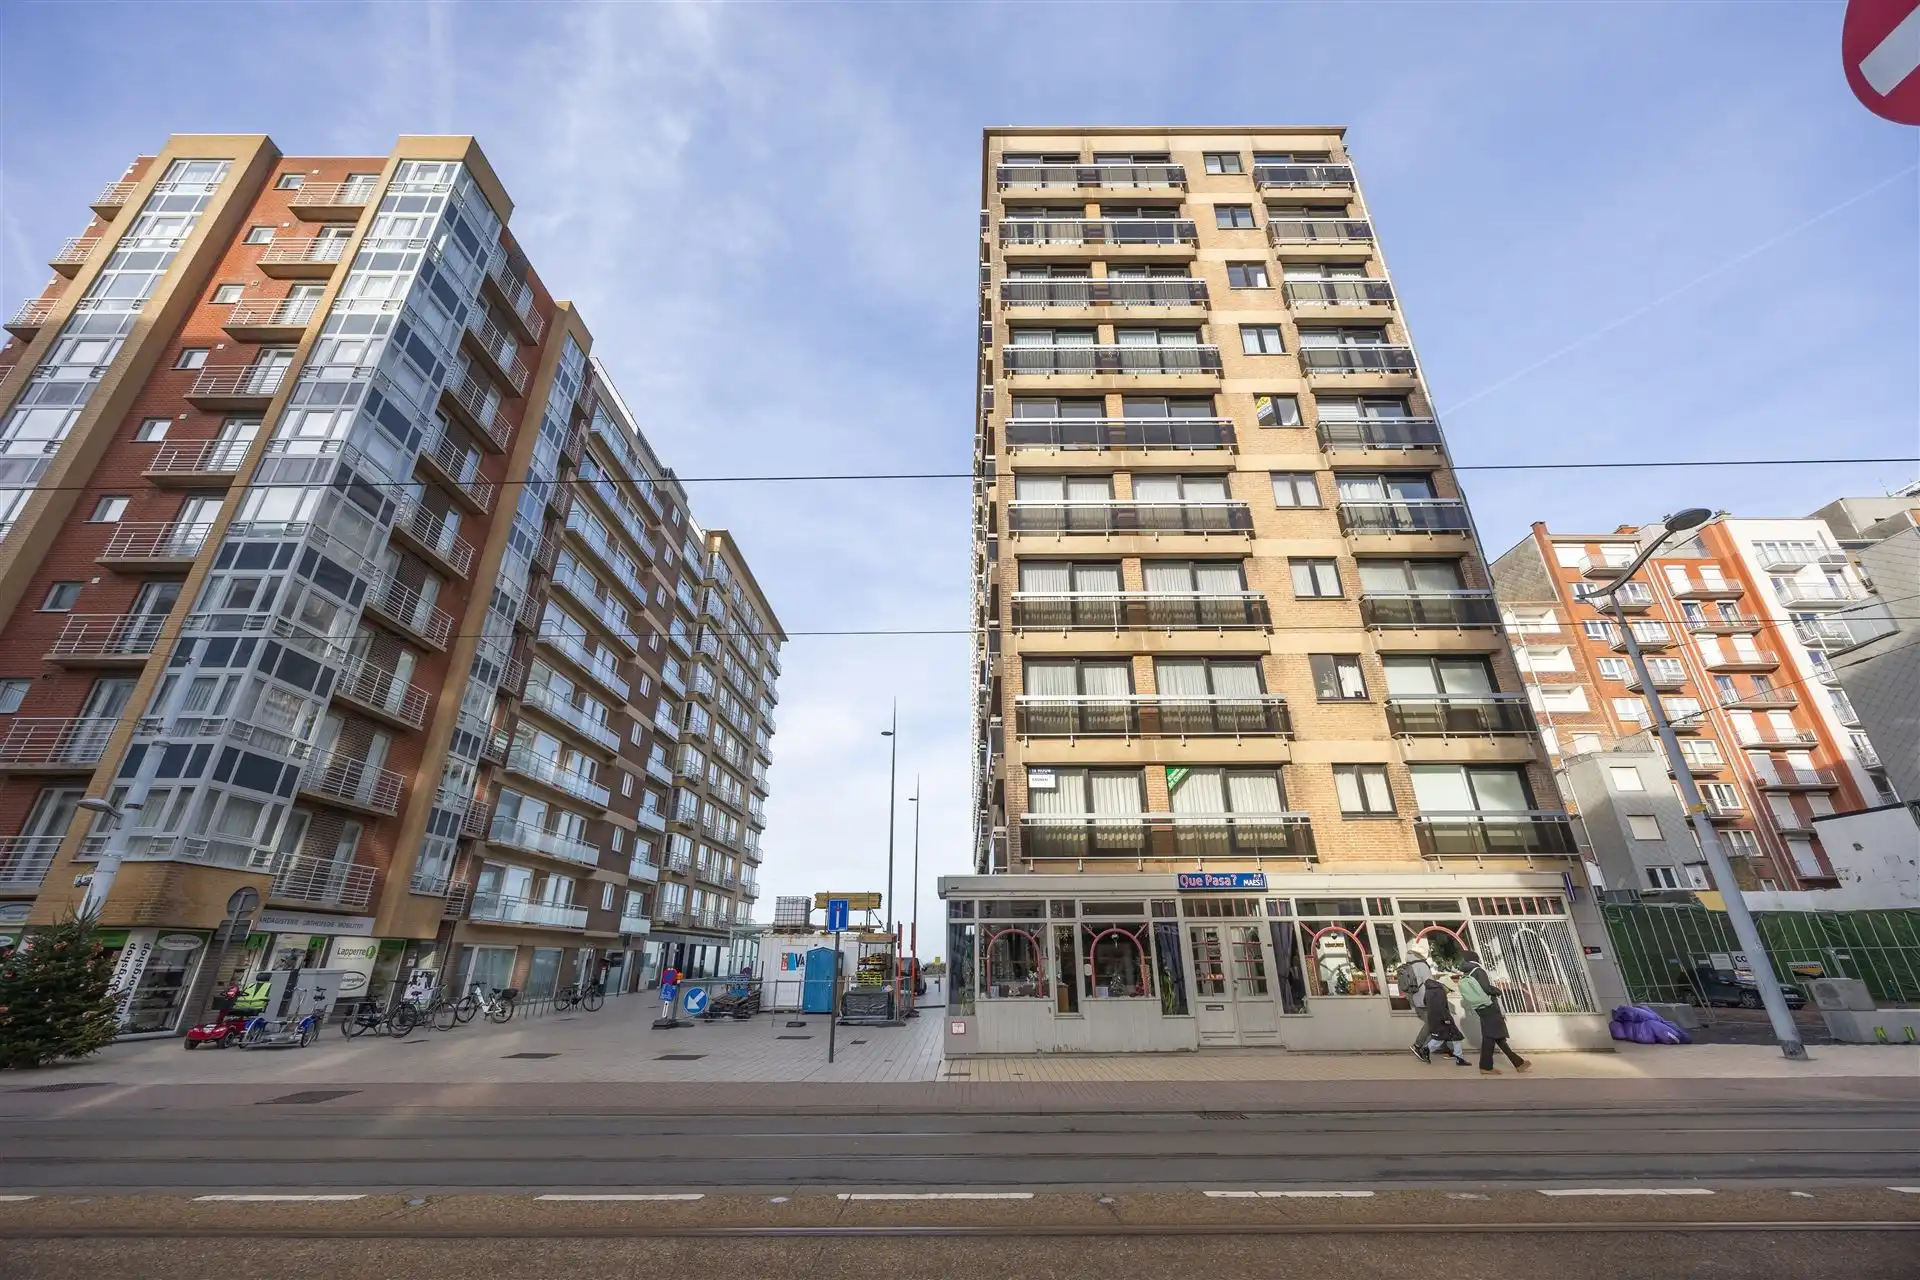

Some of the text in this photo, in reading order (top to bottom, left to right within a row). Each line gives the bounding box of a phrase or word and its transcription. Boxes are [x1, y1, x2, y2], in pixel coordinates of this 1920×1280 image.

[1179, 873, 1238, 888] Que Pasa?
[337, 946, 367, 957] Lapperre
